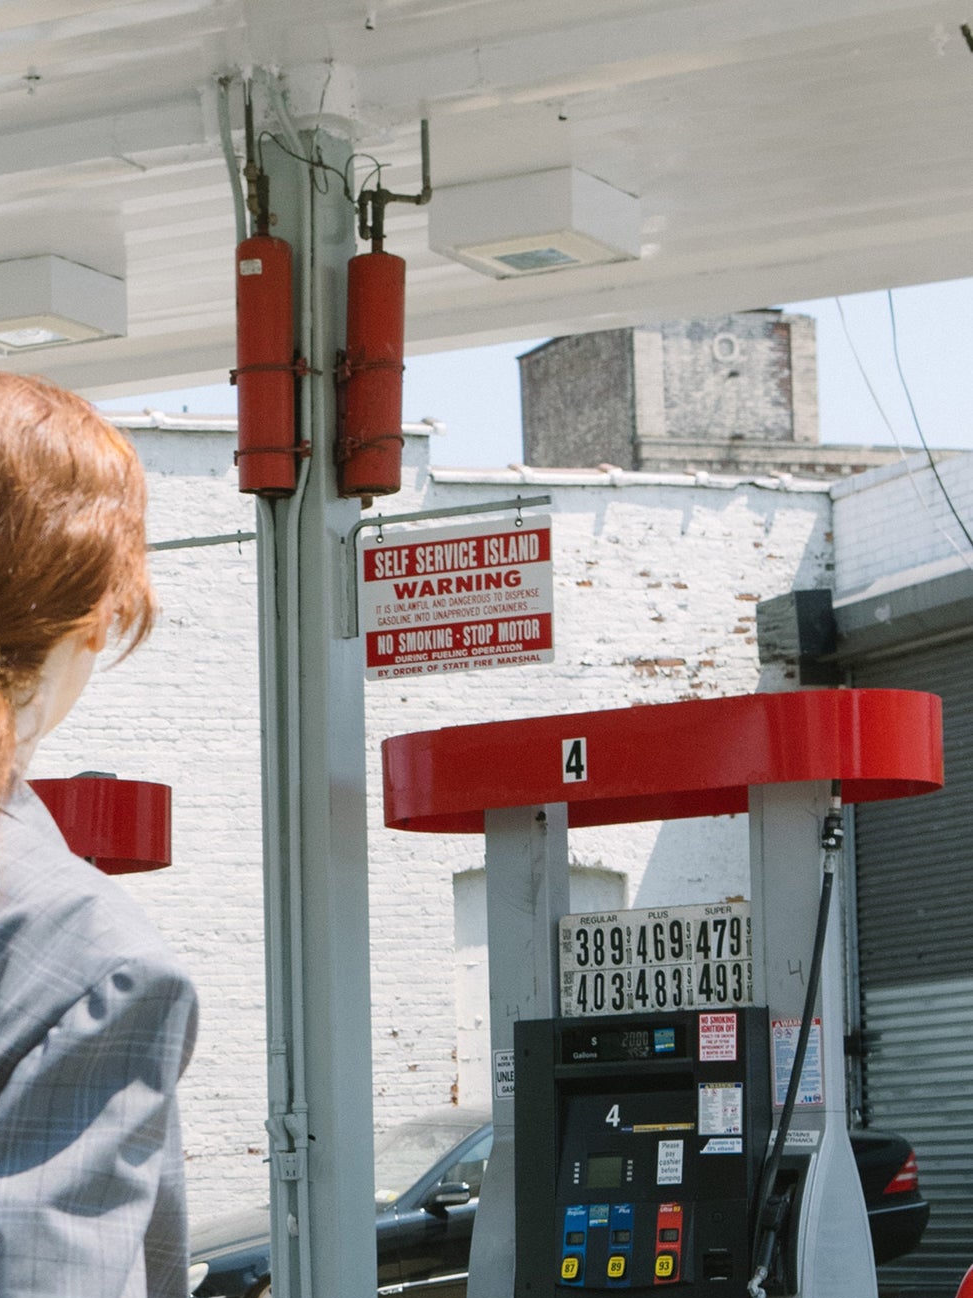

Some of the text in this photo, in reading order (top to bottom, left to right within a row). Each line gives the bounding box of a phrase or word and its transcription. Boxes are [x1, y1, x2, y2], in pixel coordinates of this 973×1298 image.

[375, 533, 539, 578] SELF SERVICE ISLAND
[393, 570, 521, 600] WARNING
[376, 588, 539, 614] IT IS UNLAWFUL AND DANGEROUS TO DISPENSE
[378, 601, 528, 626] GASOLINE INTO UNAPPROVED CONTAINERS
[377, 618, 540, 655] NO SMOKING STOP MOTOR
[393, 666, 423, 676] ORDER
[427, 664, 439, 672] OF
[443, 661, 469, 671] STATE
[473, 659, 493, 668] FIRE
[497, 654, 541, 665] MARSHAL
[395, 643, 523, 664] DURING FUELING OPERATION
[566, 740, 585, 780] 4
[580, 905, 731, 925] REGULAR PLUS SUPER
[788, 960, 804, 986] 4
[701, 1016, 735, 1024] NO SMOKING
[573, 1052, 598, 1060] Gallons
[606, 1104, 621, 1128] 4
[564, 1264, 575, 1273] 87
[611, 1263, 622, 1272] 89
[658, 1261, 670, 1270] 93
